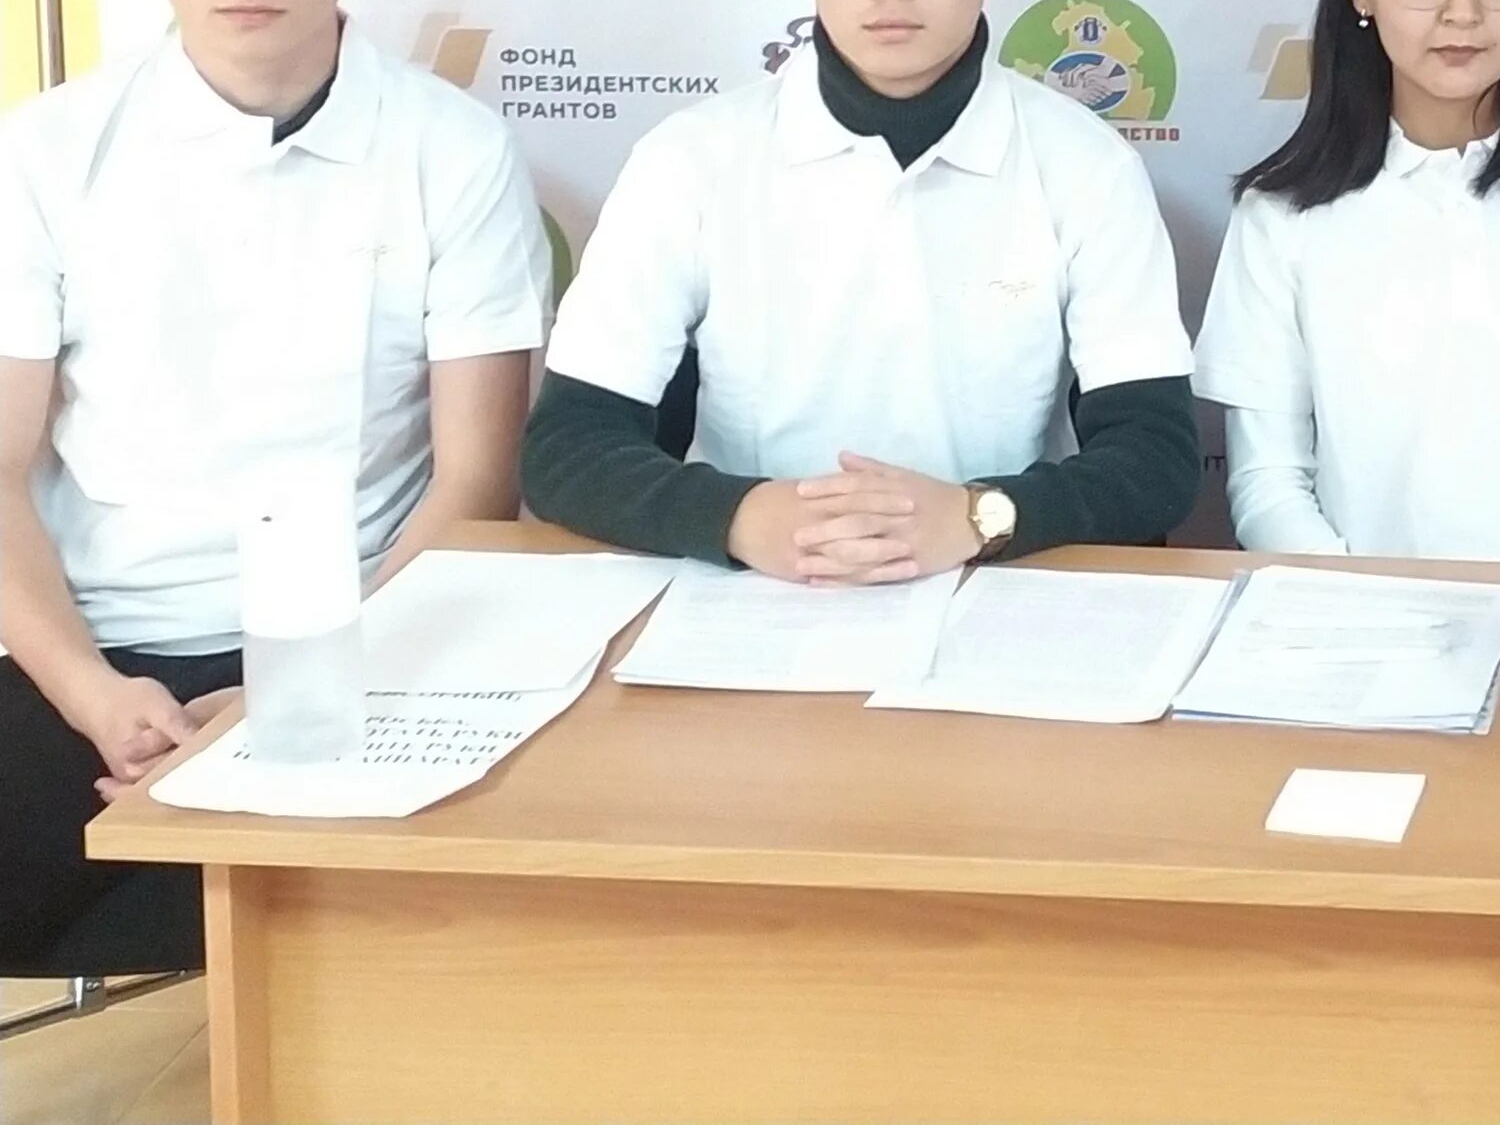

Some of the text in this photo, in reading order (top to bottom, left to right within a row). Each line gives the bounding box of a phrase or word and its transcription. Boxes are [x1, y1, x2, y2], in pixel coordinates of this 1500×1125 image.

[499, 48, 577, 69] ФОНД
[501, 74, 719, 96] ПРЕЗИДЕНТСКИХ
[502, 101, 617, 120] ГРАНТОВ
